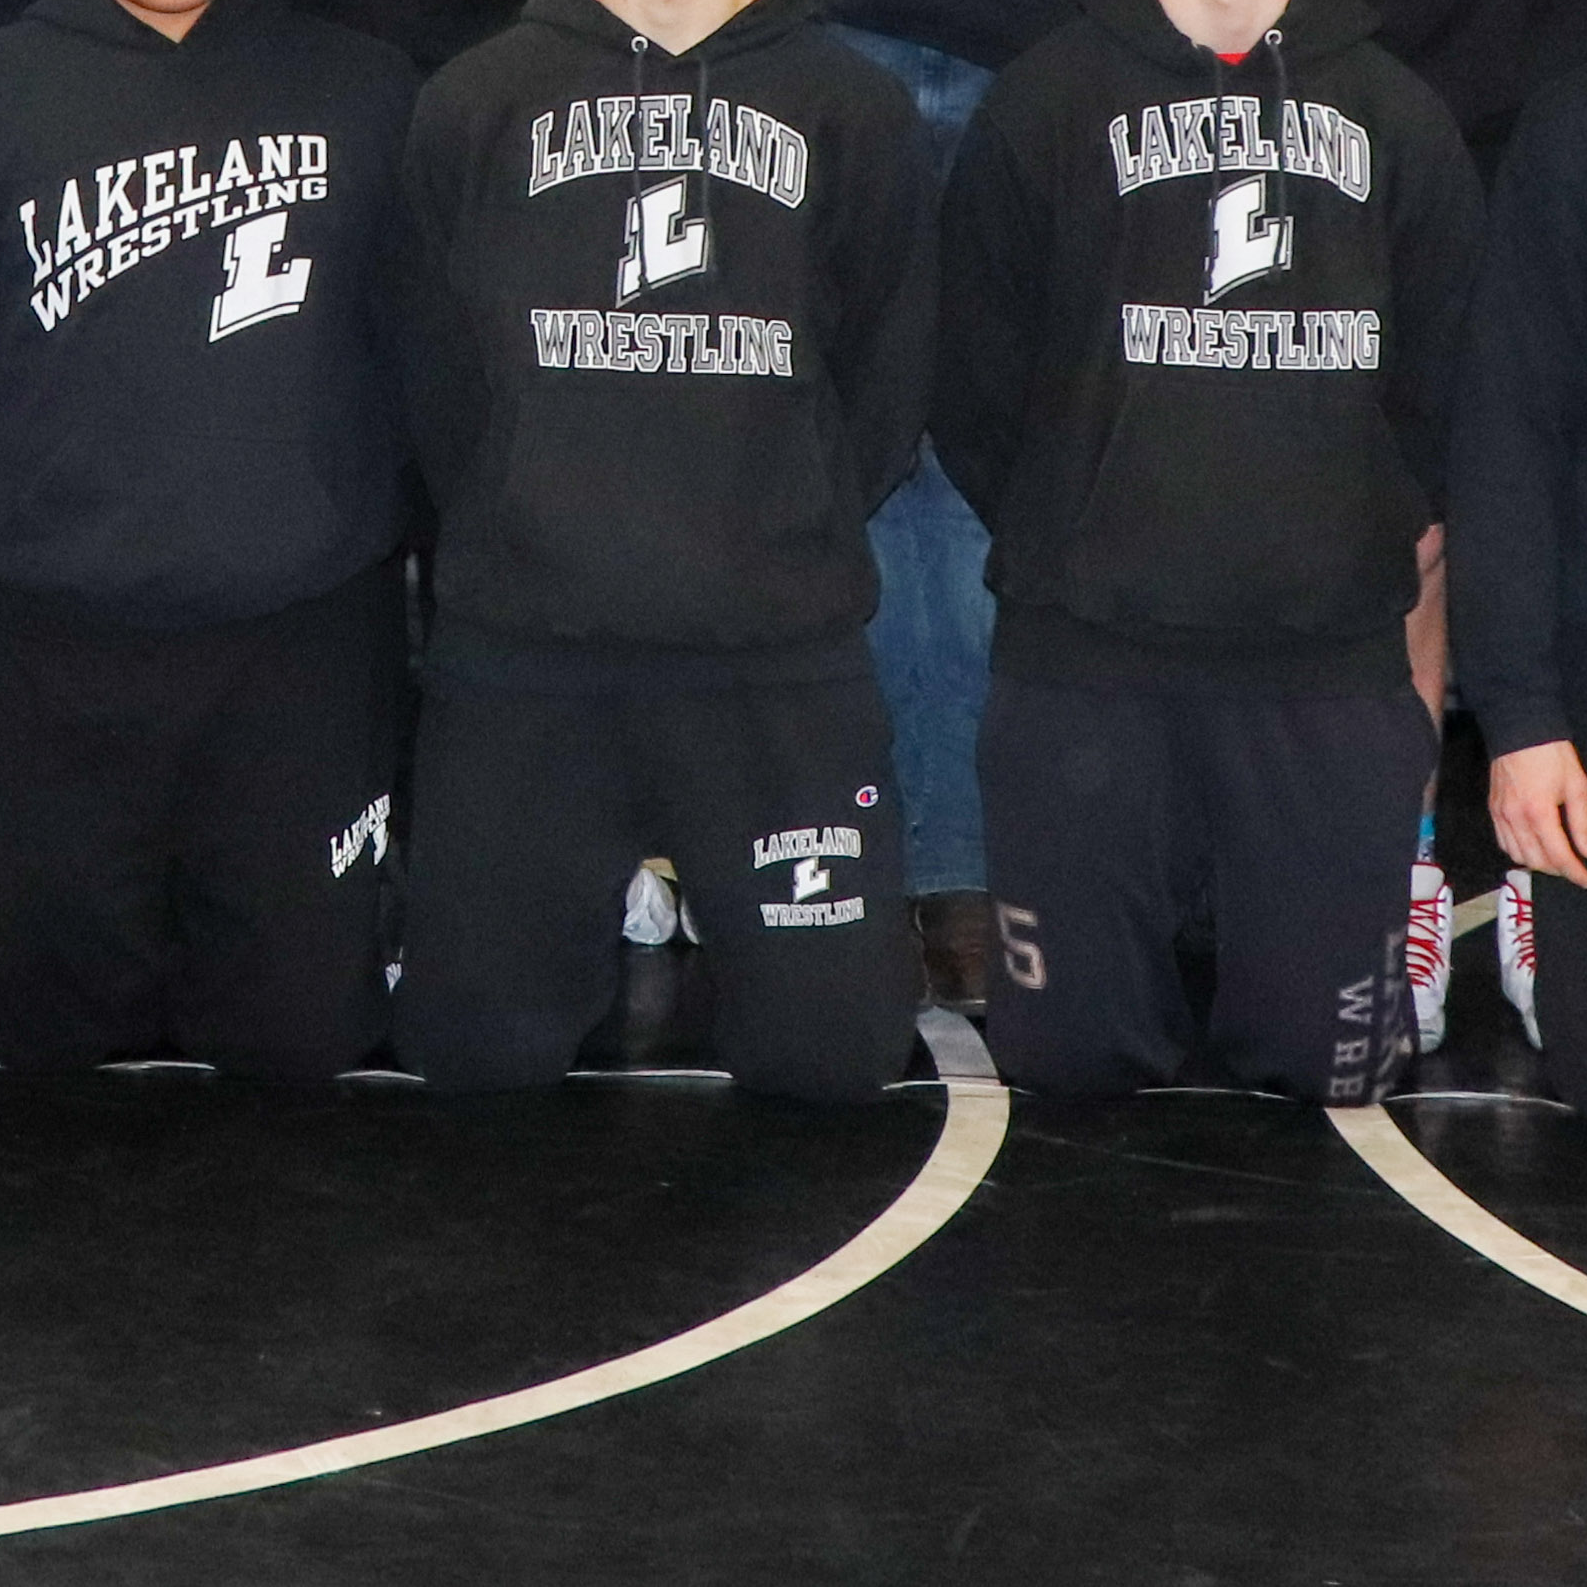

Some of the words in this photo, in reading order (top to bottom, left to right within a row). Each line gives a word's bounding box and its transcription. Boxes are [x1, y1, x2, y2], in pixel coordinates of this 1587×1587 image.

[528, 94, 808, 209] LAKELAND
[1110, 96, 1371, 203] LAKELAND
[19, 133, 328, 278] LAKELAND
[29, 175, 328, 332] WRESTLING
[529, 309, 793, 378] WRESTLING
[1122, 303, 1380, 371] WRESTLING
[753, 826, 862, 869] LAKELAND
[760, 897, 865, 927] WRESTLING
